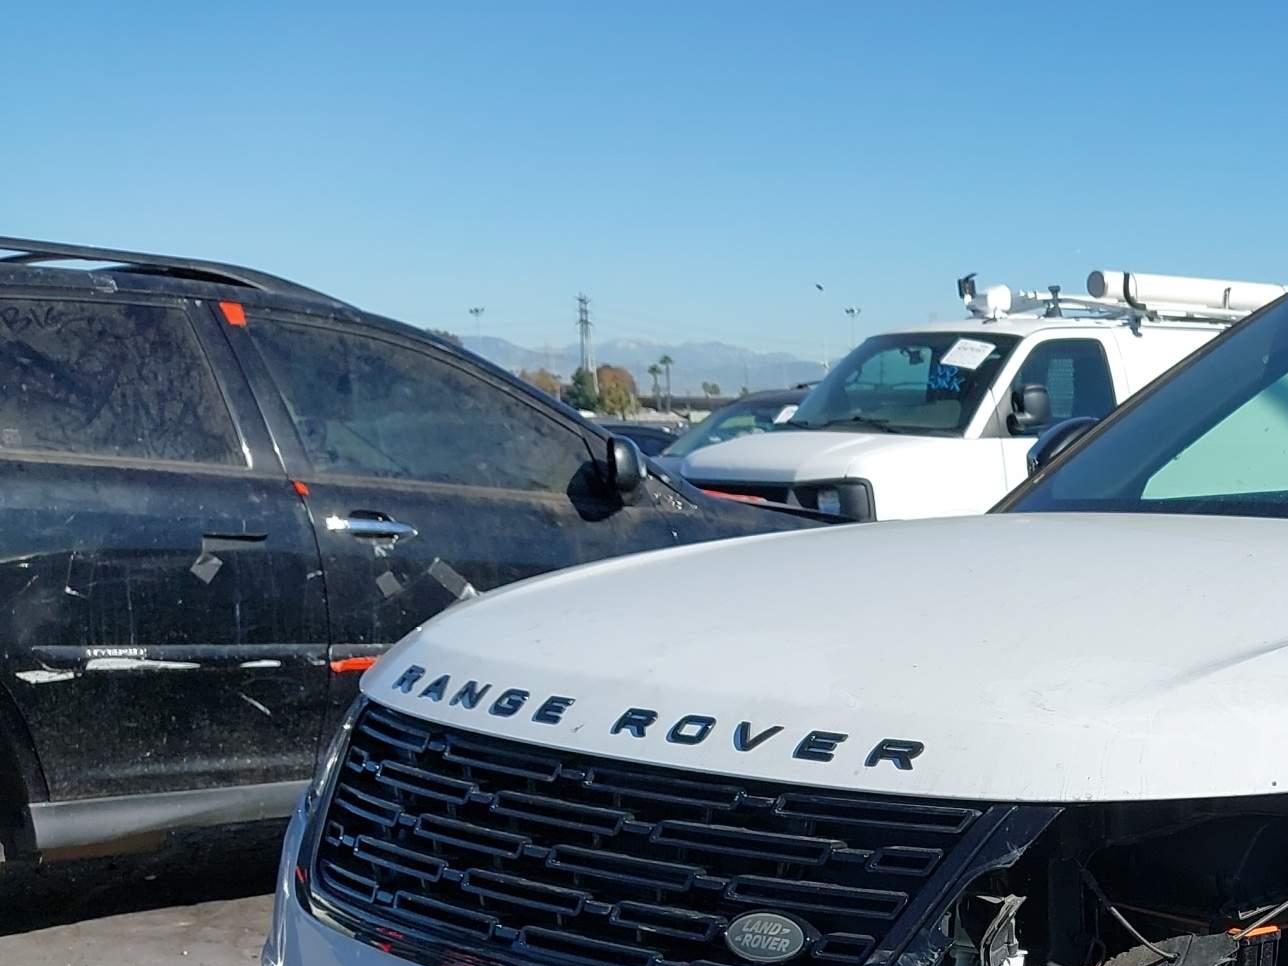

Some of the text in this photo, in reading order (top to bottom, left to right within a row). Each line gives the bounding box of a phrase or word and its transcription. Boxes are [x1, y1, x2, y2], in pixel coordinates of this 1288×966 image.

[391, 664, 926, 771] RANGE ROVER
[742, 920, 782, 935] LAND
[741, 933, 790, 952] ROVER
